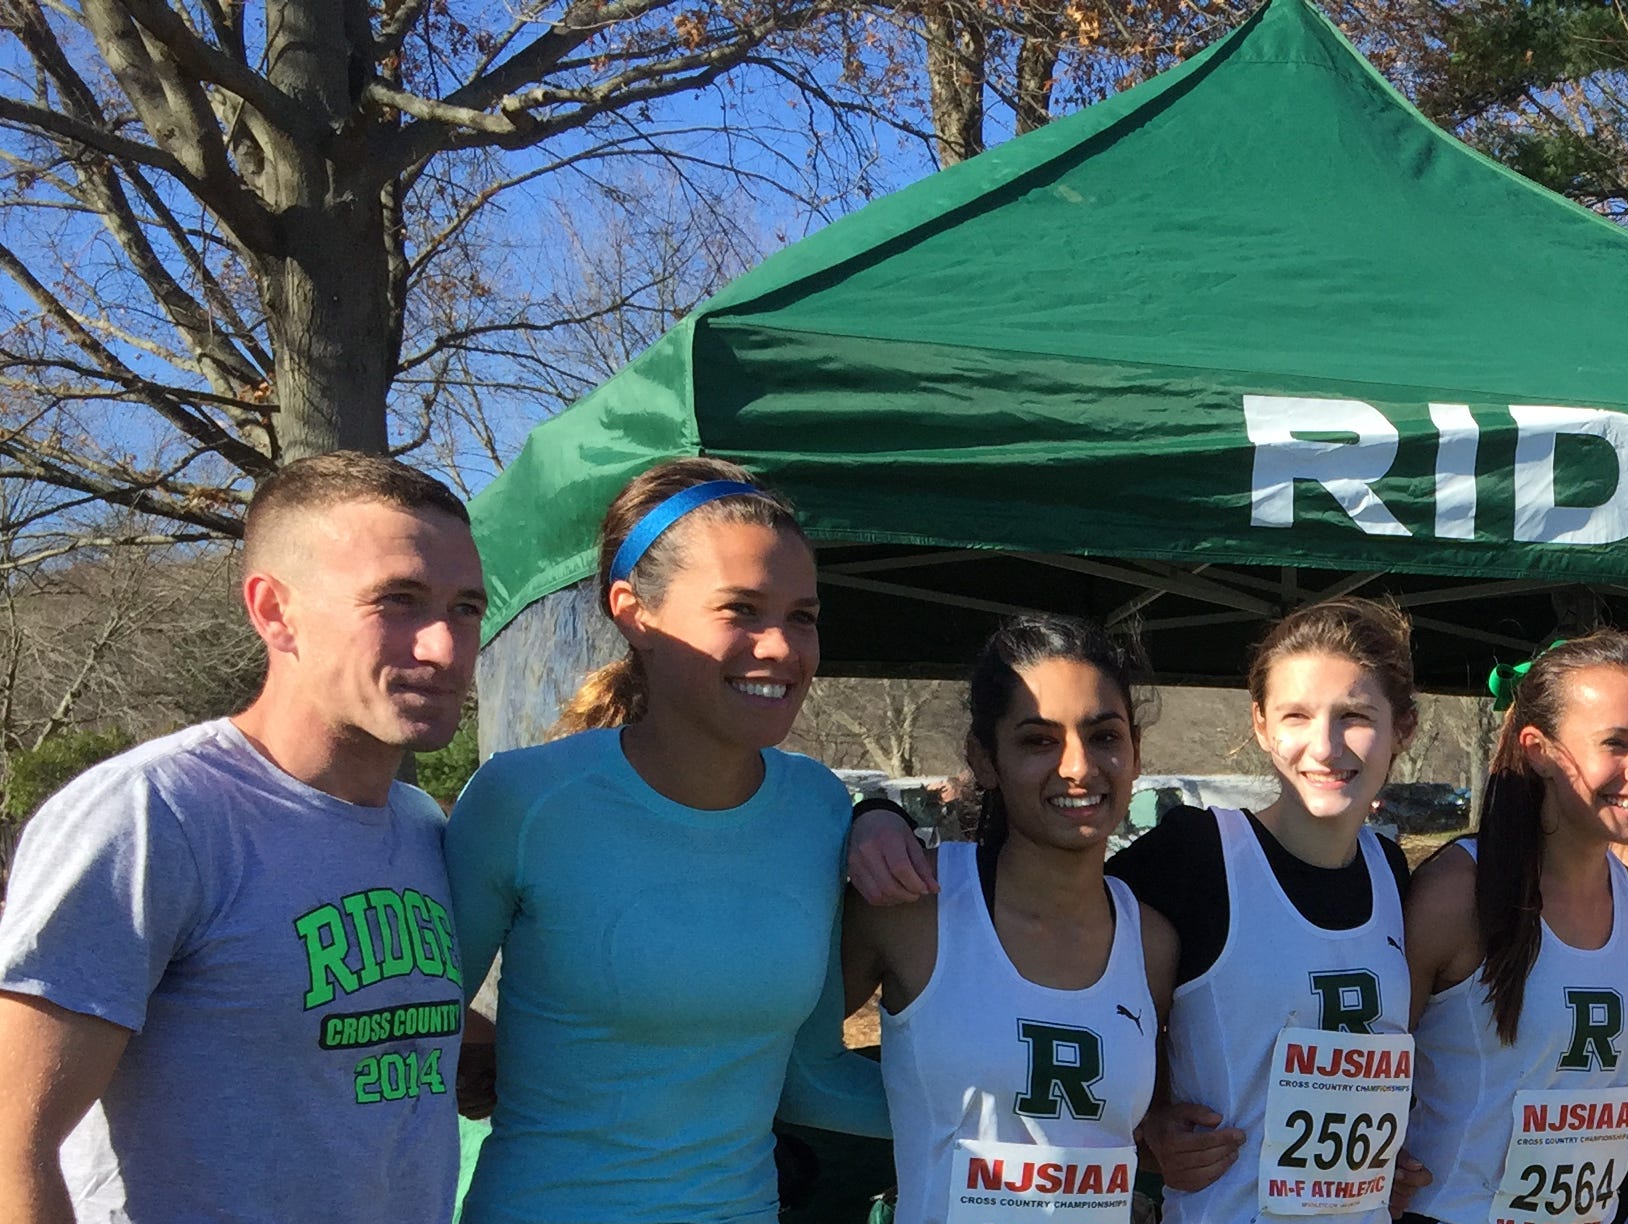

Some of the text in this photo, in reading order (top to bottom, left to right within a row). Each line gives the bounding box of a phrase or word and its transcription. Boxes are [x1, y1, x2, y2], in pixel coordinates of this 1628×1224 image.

[293, 887, 463, 1012] RIDGE
[326, 1004, 459, 1045] CROSS COUNTR
[1308, 968, 1385, 1034] R
[1555, 986, 1625, 1072] R
[354, 1048, 447, 1104] 2014
[1013, 1017, 1106, 1121] R
[1284, 1043, 1411, 1079] NJSIAA
[1279, 1079, 1309, 1089] CROSS
[1311, 1082, 1353, 1092] COUNTRY
[1278, 1110, 1397, 1171] 2562
[1517, 1138, 1543, 1146] CROSS
[1545, 1136, 1578, 1145] COUNTRY
[967, 1157, 1130, 1194] NJSIAA
[1269, 1175, 1385, 1198] M-F ATHLETIC
[1509, 1158, 1615, 1216] 2564
[960, 1195, 1128, 1209] CROSS COUNTRY CHAMPIONSHIPS
